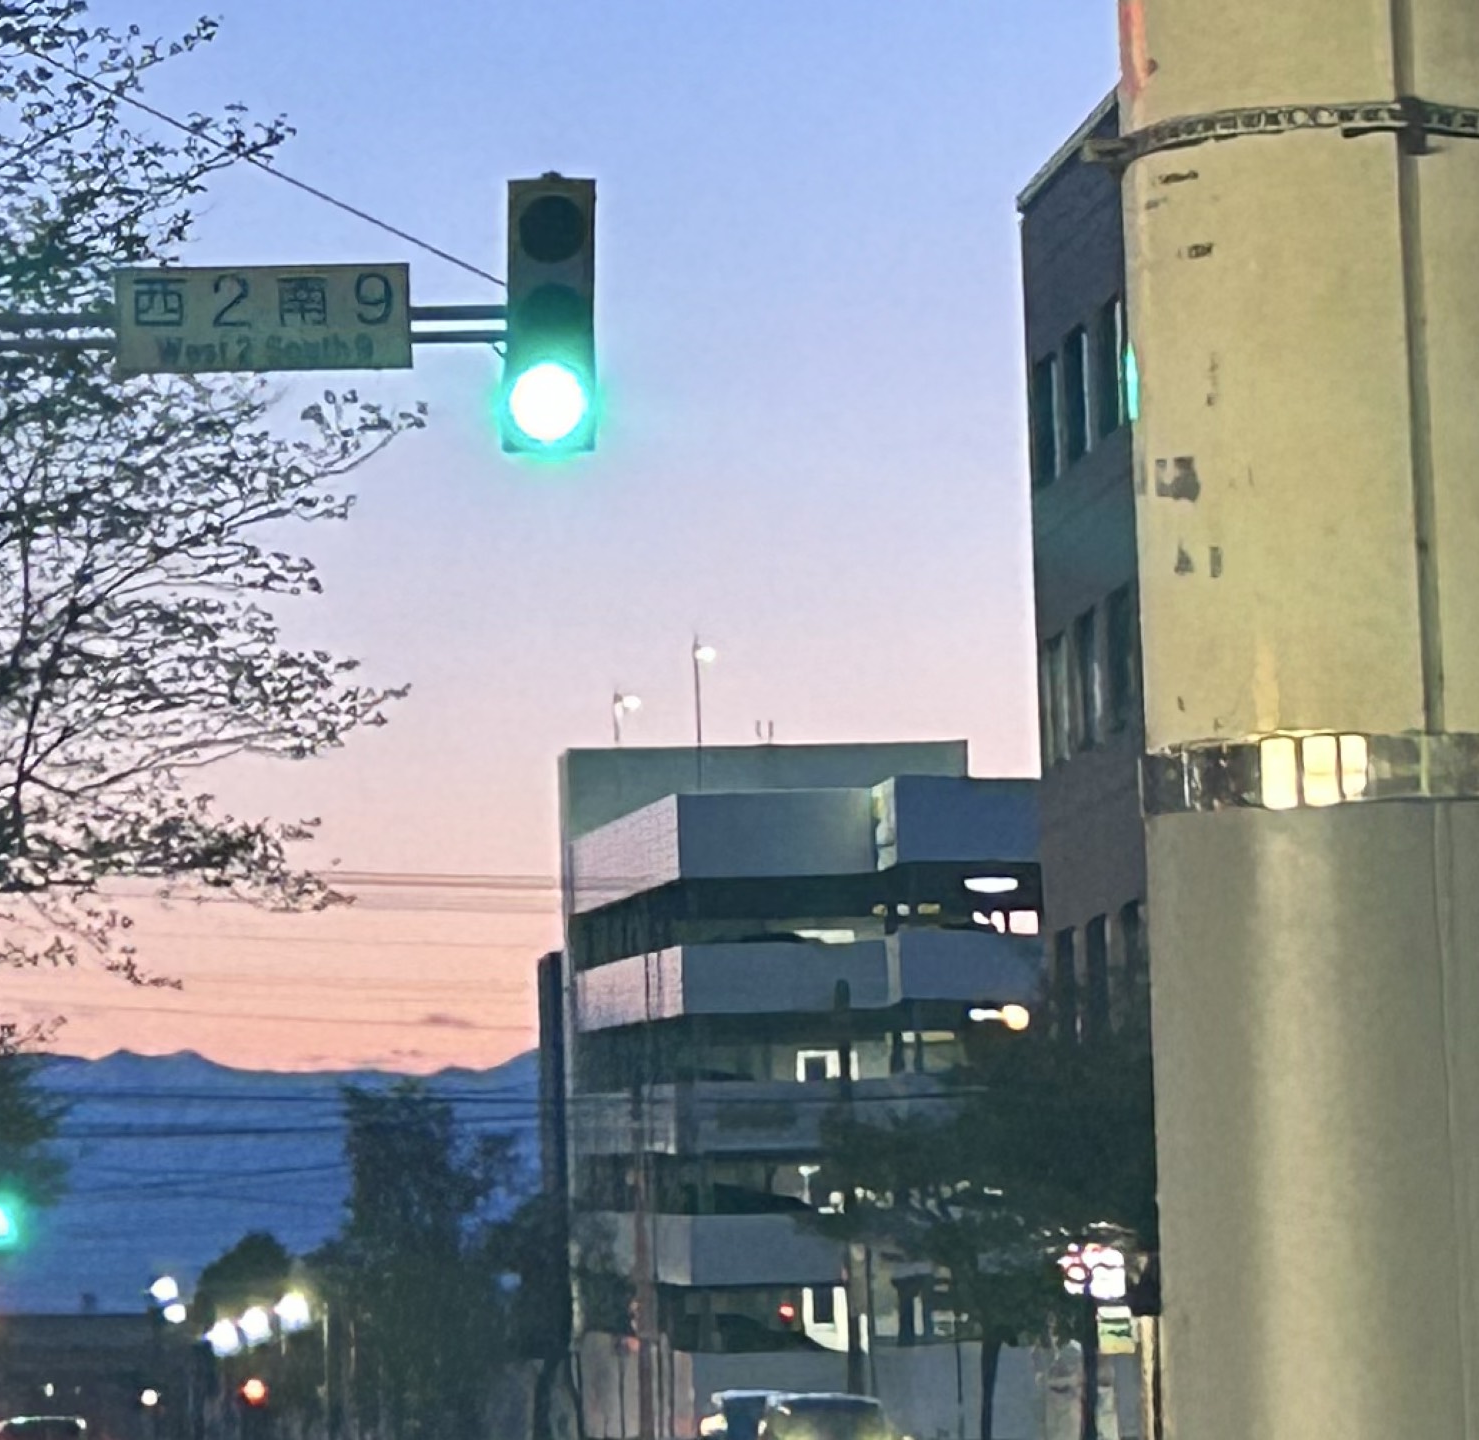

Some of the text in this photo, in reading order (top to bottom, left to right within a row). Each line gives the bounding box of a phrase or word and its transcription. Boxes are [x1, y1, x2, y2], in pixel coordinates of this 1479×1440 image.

[158, 331, 374, 366] West 2 South 9
